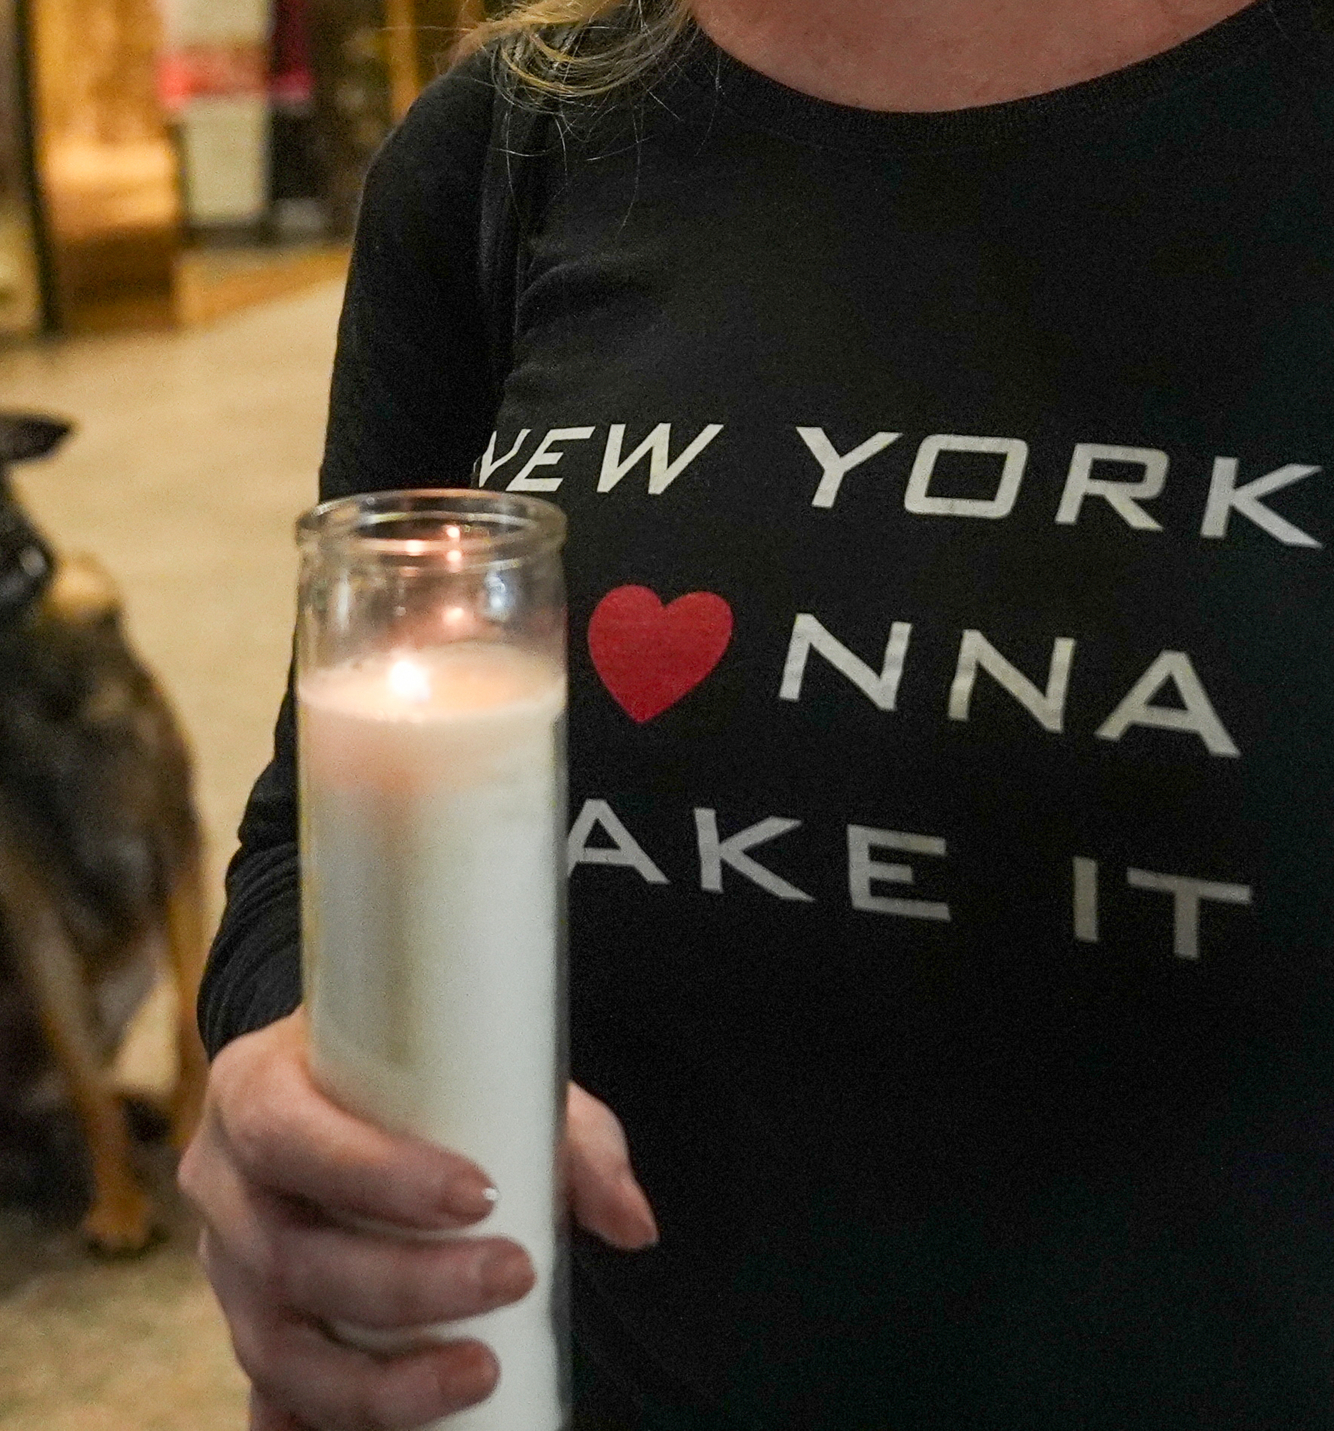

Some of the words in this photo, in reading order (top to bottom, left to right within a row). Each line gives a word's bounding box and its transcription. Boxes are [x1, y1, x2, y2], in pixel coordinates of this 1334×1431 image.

[475, 423, 724, 495] NEW
[567, 799, 949, 919] AKE
[1073, 855, 1252, 959] IT
